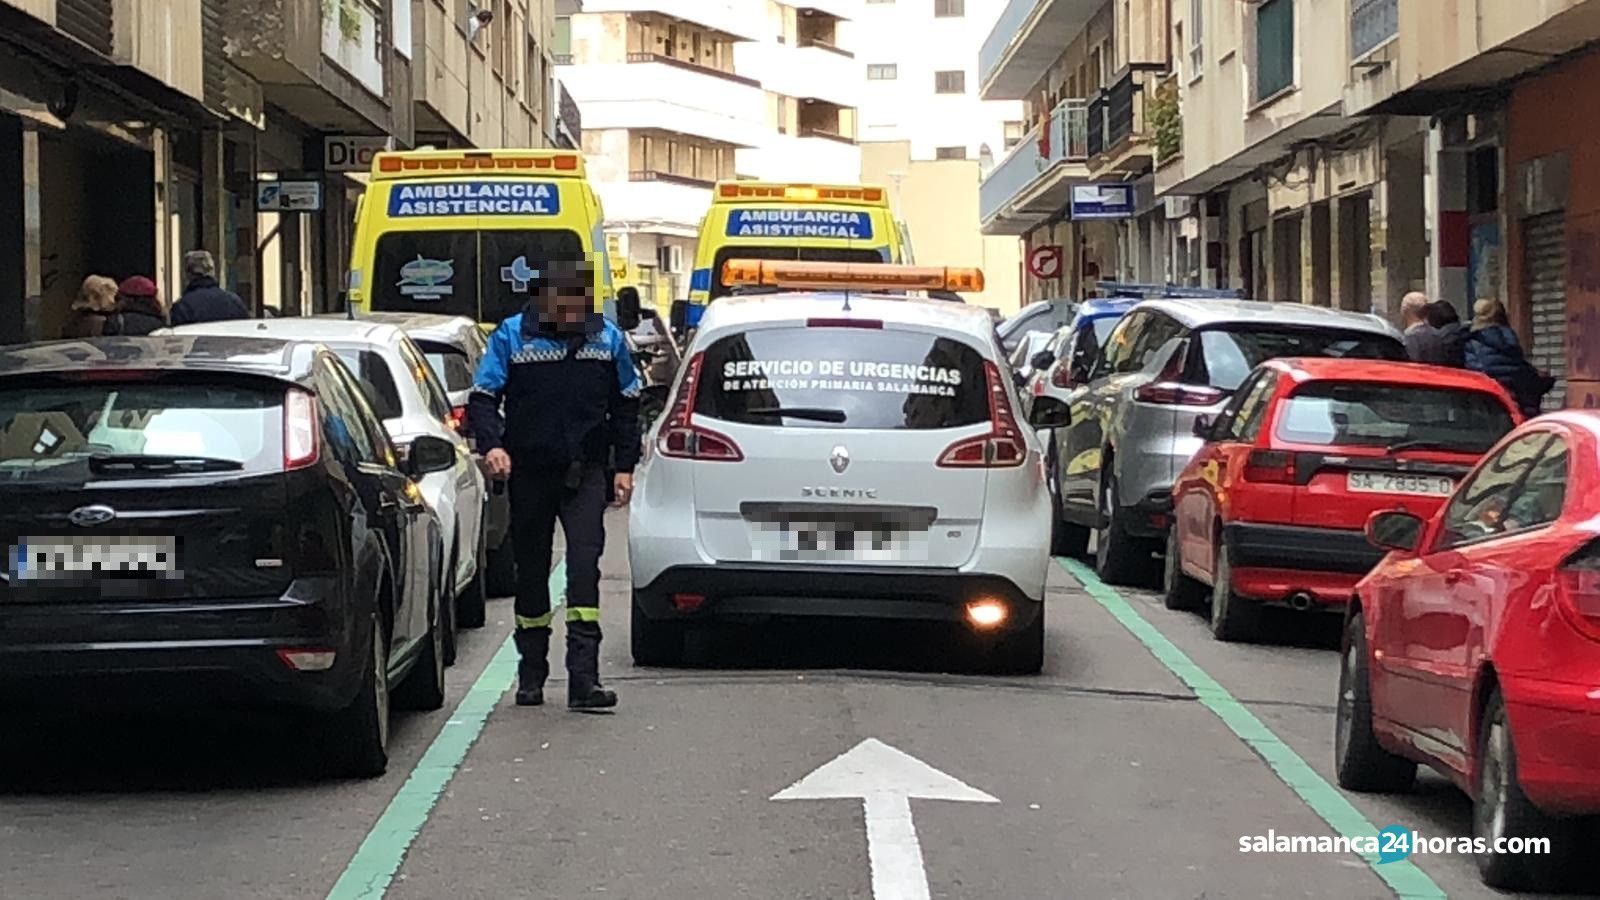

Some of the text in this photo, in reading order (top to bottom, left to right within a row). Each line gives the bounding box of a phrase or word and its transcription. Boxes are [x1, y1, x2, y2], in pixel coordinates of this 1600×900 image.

[329, 141, 386, 165] Dic
[400, 184, 550, 200] AMBULANCIA
[399, 200, 549, 214] ASISTENCIAL
[739, 210, 860, 224] AMBULANCIA
[739, 224, 860, 237] ASISTENCIAL
[723, 360, 961, 385] SERVICIO DE URGENCIAS
[723, 379, 739, 391] DE
[811, 379, 874, 391] PRIMARIA
[878, 382, 955, 396] SALAMANCA
[801, 486, 878, 499] SCENIC
